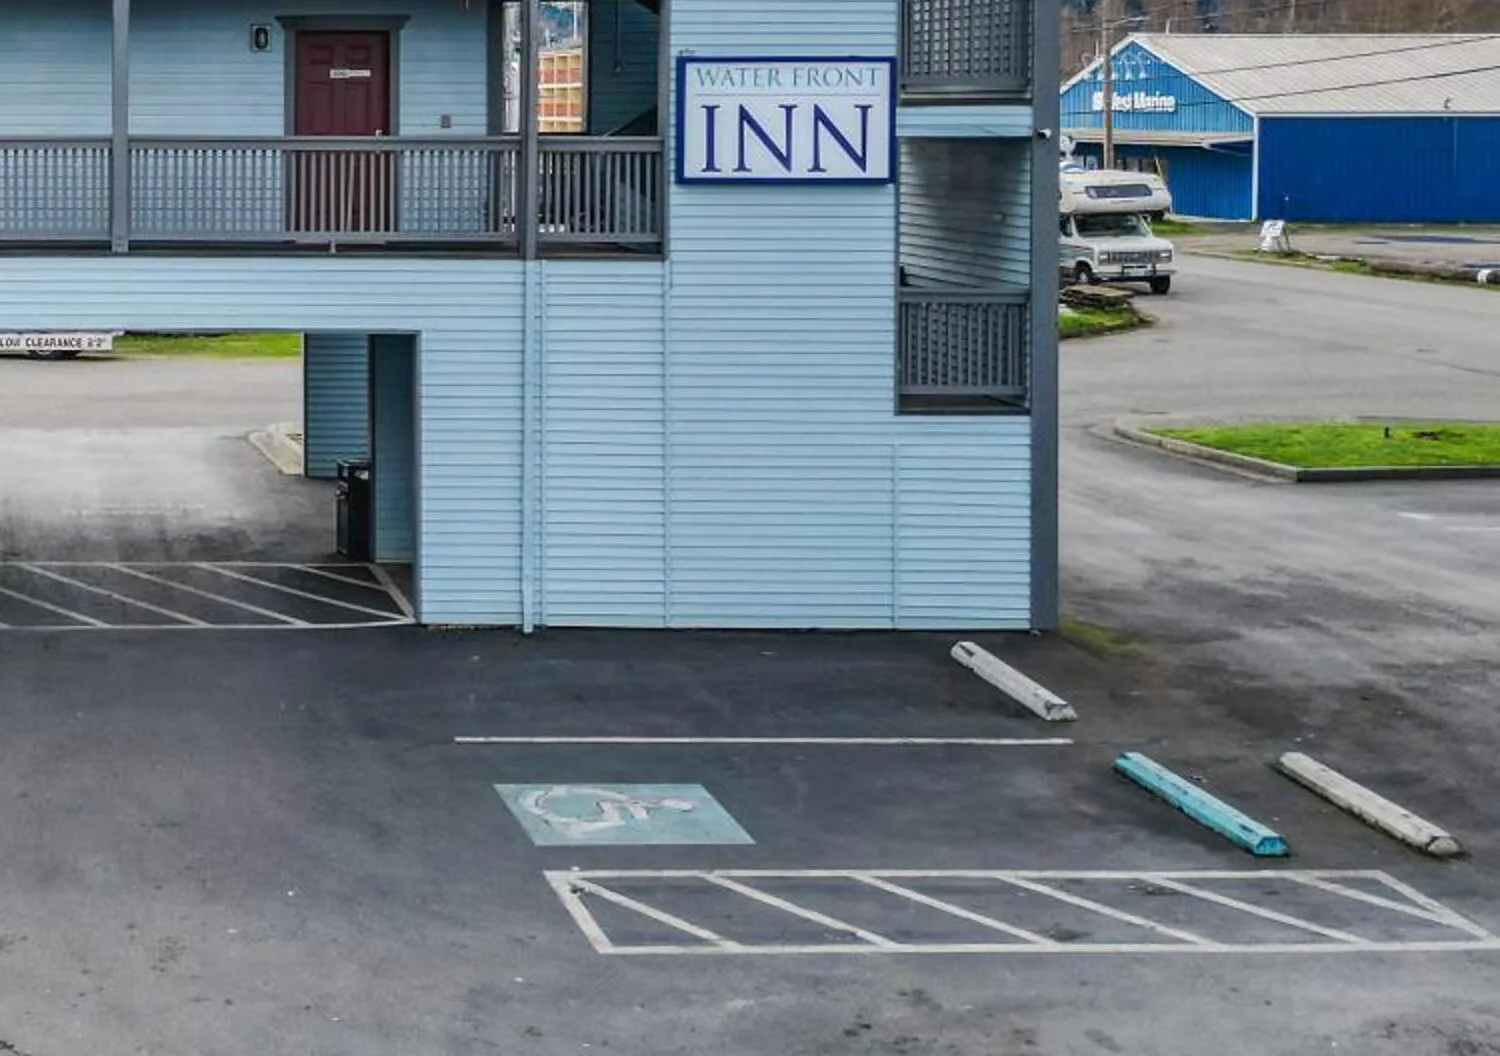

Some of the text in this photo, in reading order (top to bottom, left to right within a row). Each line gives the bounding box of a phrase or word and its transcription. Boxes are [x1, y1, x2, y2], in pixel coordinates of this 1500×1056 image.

[695, 67, 883, 88] WATER FRONT
[700, 104, 873, 174] INN
[25, 336, 82, 348] CLEARANCE
